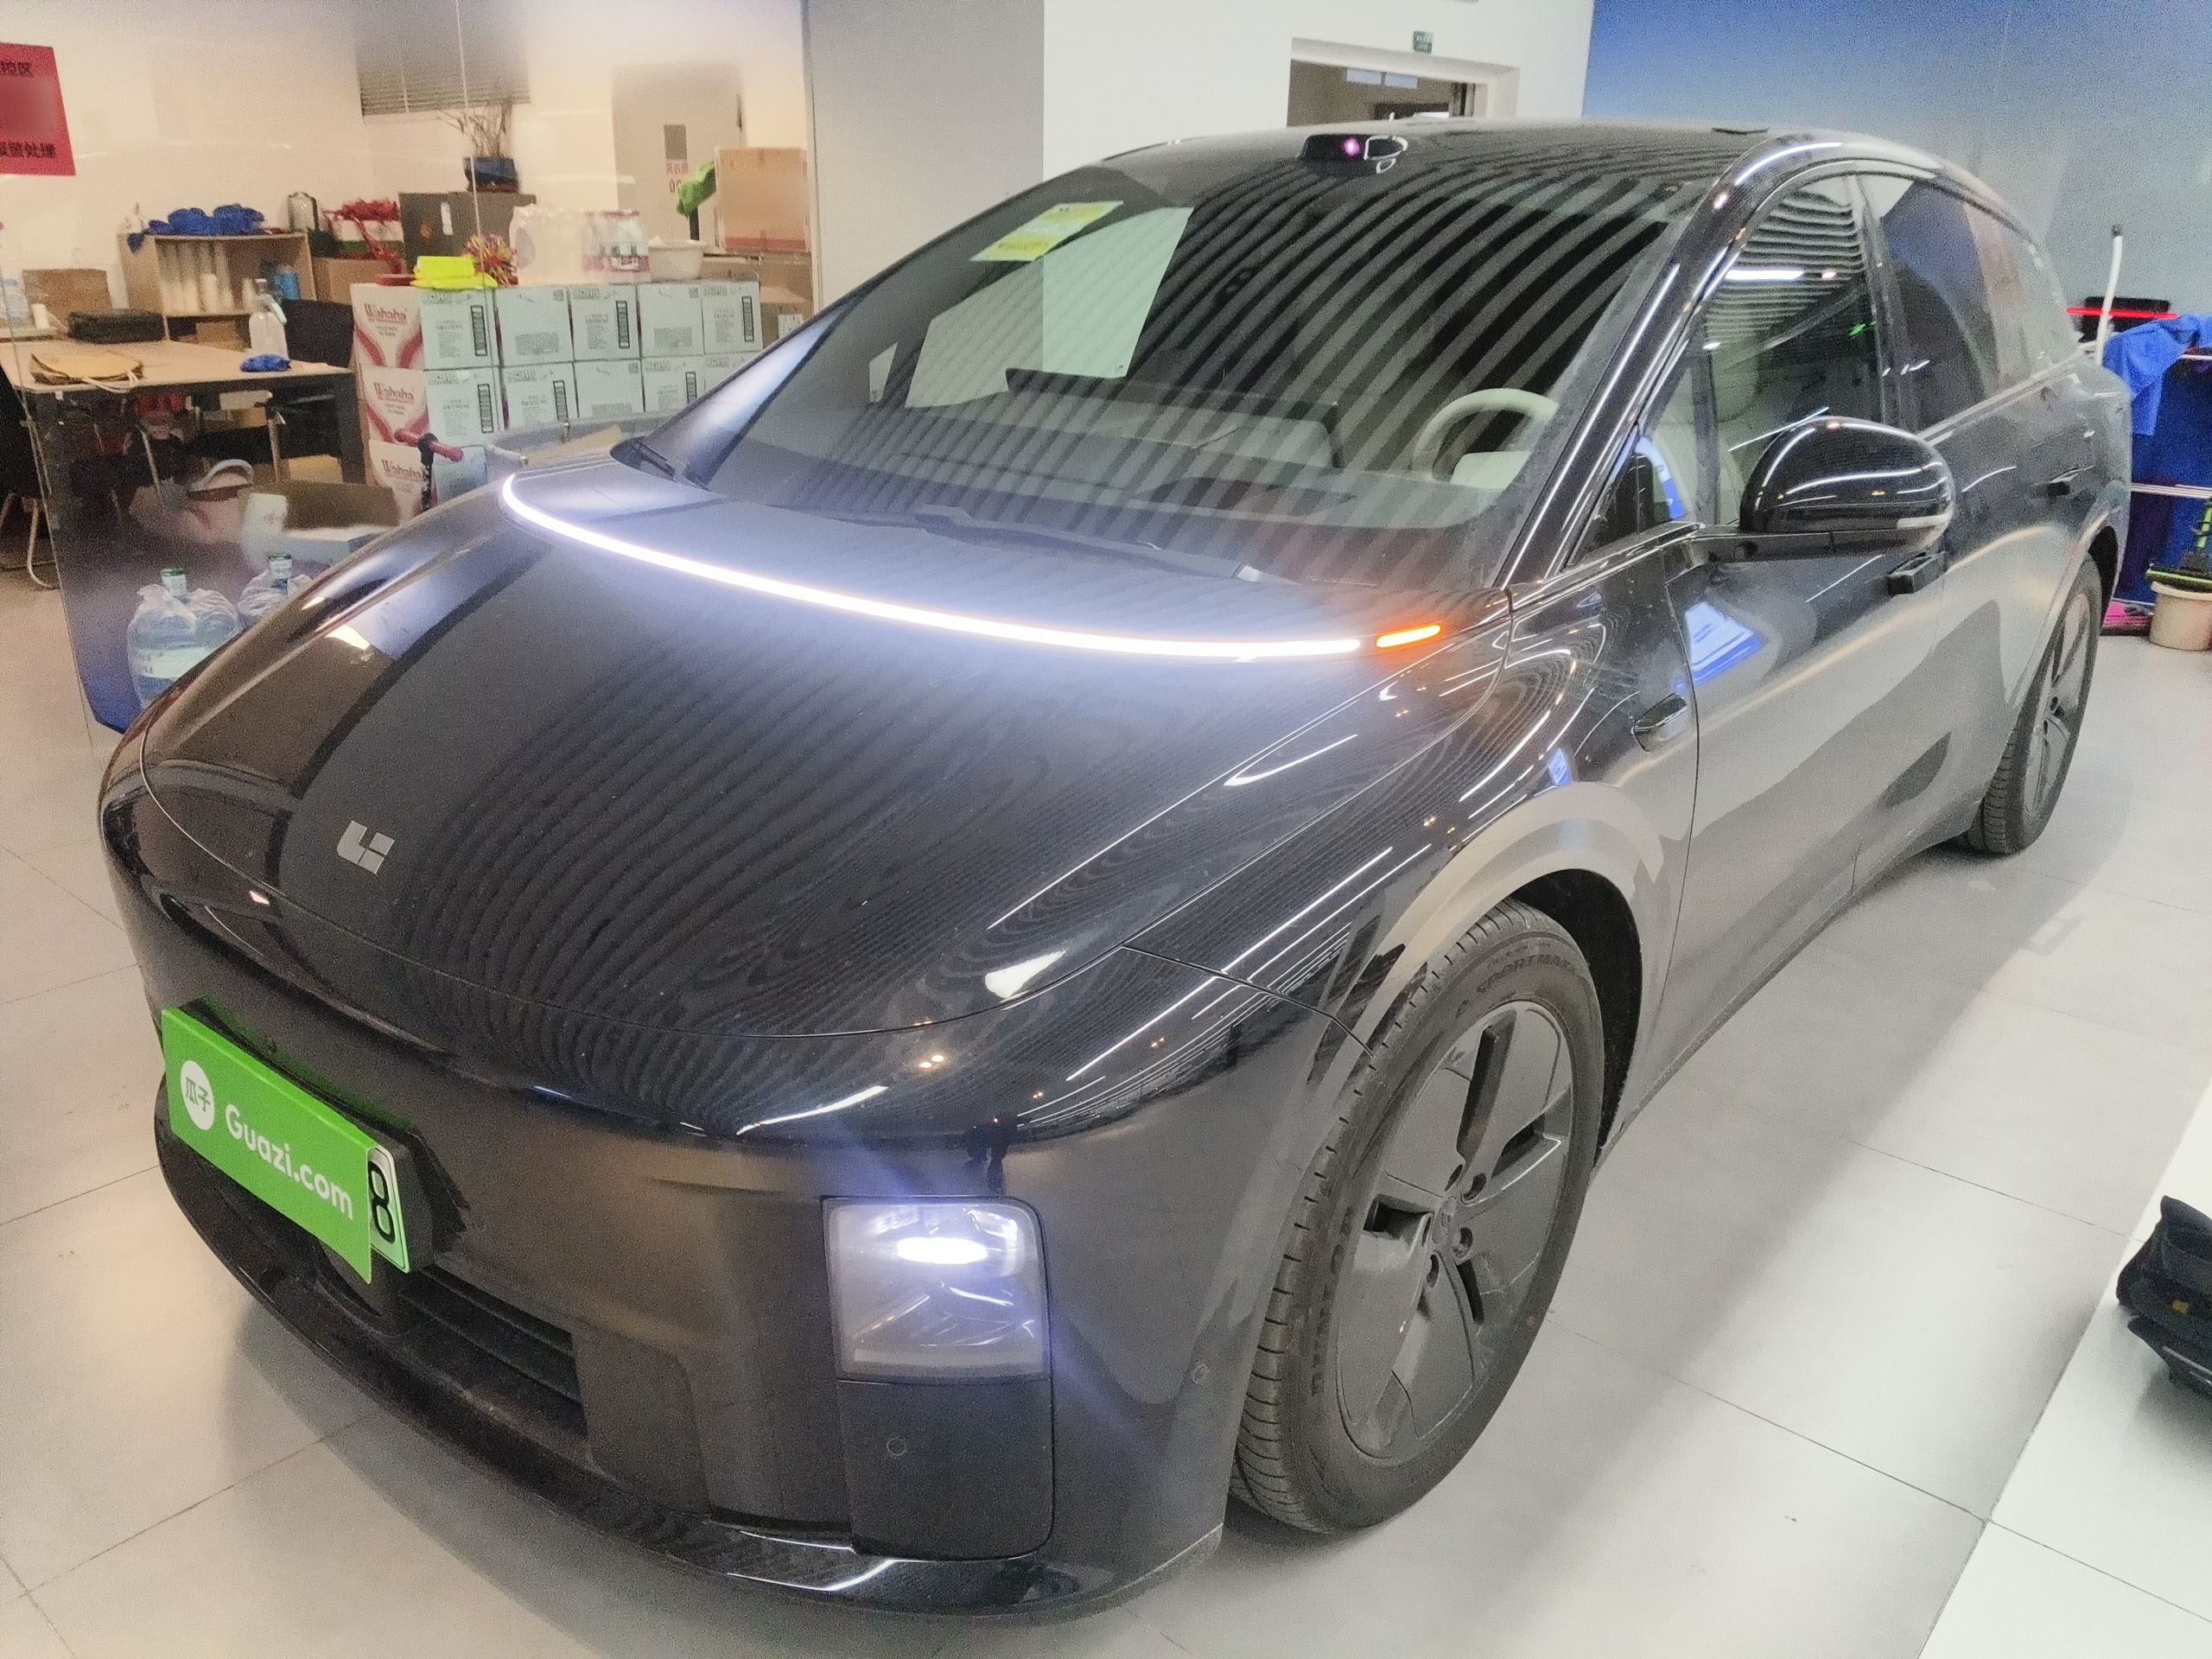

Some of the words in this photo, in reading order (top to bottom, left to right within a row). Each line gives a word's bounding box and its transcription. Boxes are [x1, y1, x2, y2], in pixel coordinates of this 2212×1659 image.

[364, 303, 406, 321] Wahaha
[373, 382, 415, 400] Wahaha
[185, 1076, 212, 1114] 瓜子
[225, 1103, 354, 1221] Guazi.com
